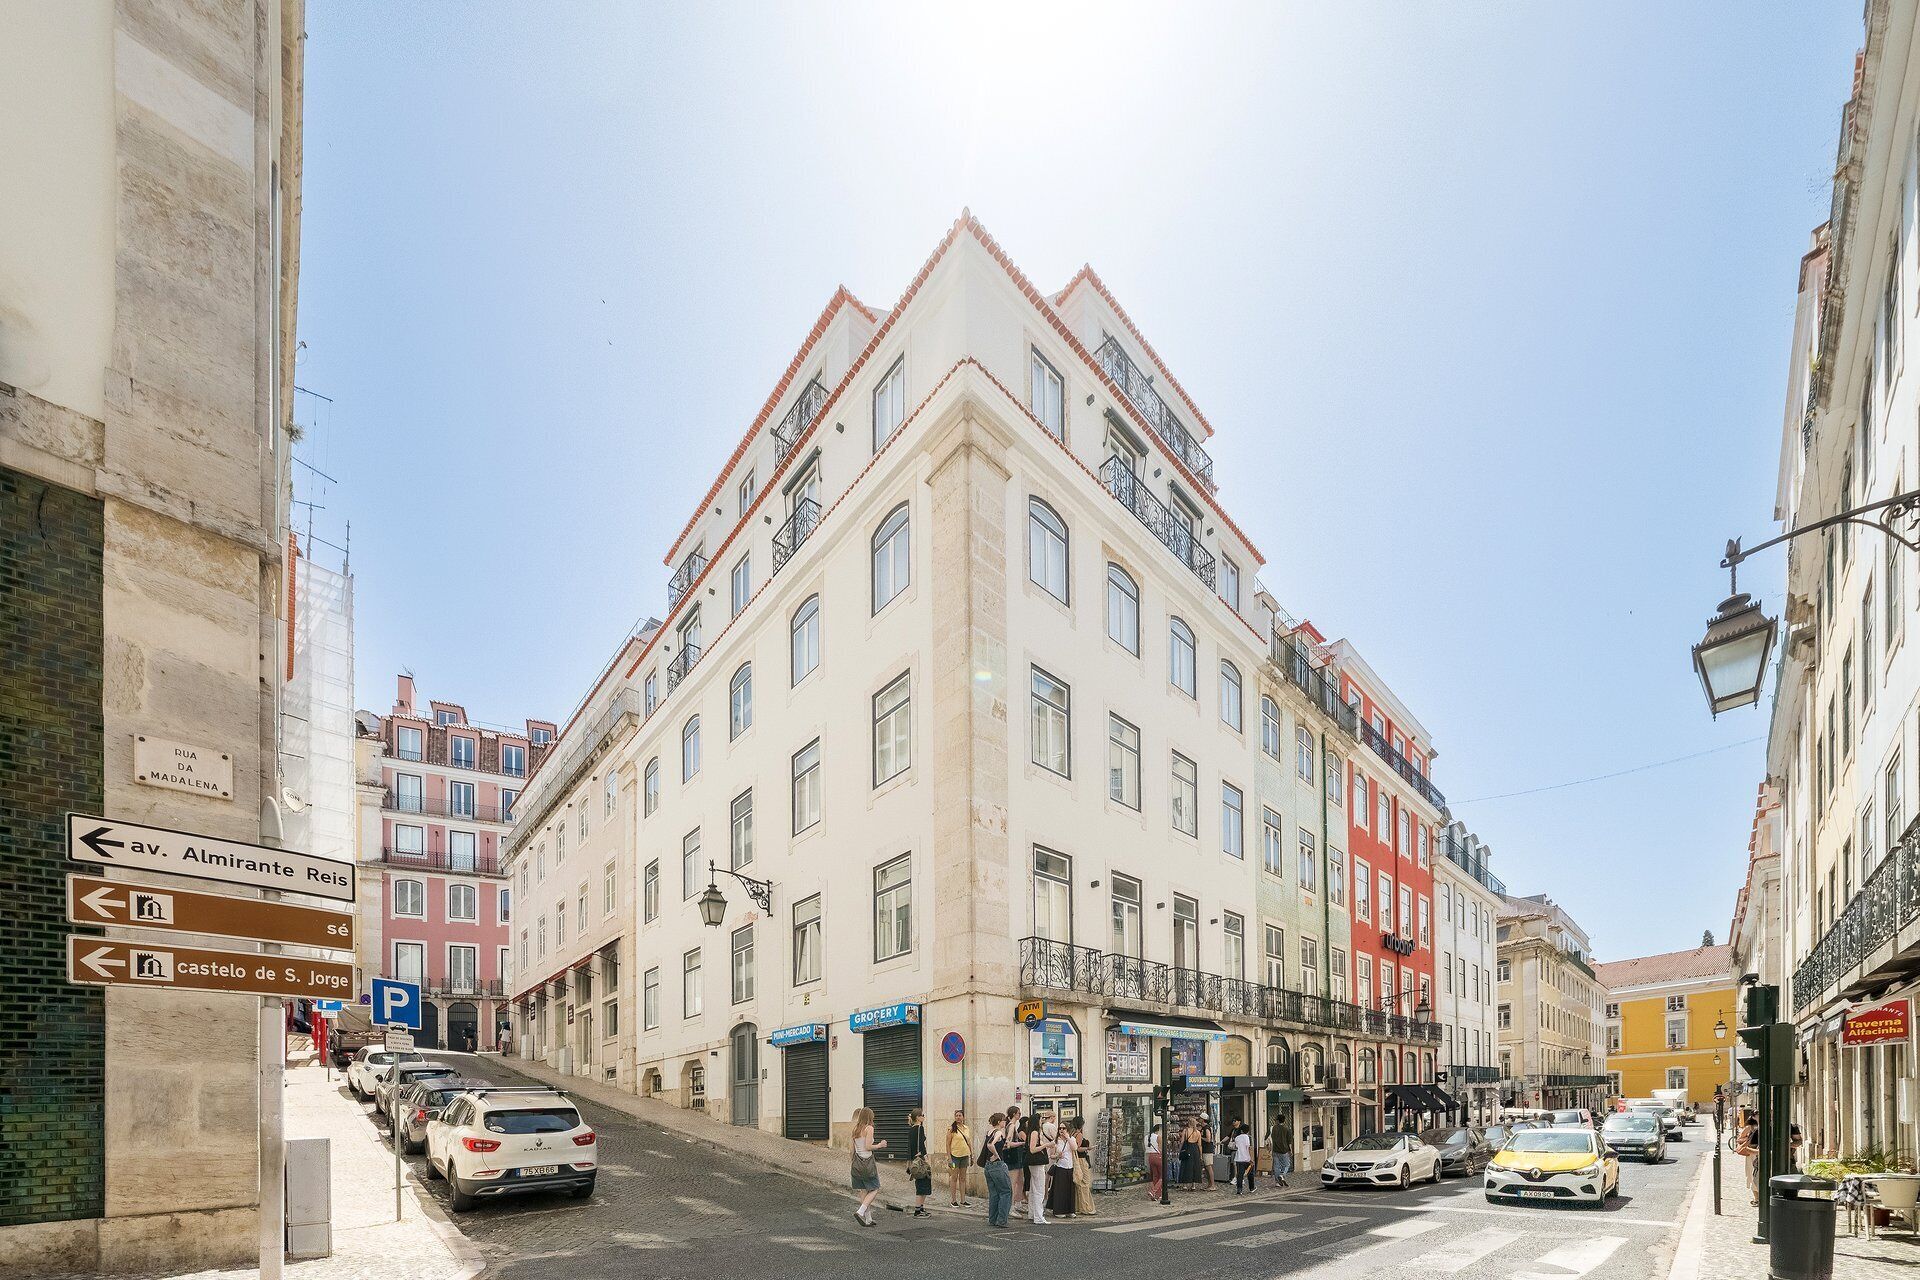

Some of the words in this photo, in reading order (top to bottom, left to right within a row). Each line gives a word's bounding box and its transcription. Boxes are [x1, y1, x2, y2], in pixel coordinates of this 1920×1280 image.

[174, 748, 197, 760] RUA
[177, 762, 193, 773] DA
[150, 770, 219, 792] MADALENA
[130, 840, 168, 857] av.
[182, 846, 295, 878] Almirante
[307, 866, 348, 887] Reis
[326, 922, 349, 937] sé
[176, 961, 246, 979] castelo
[255, 965, 276, 981] de
[284, 968, 301, 983] S.
[307, 970, 349, 989] Jorge
[383, 986, 410, 1020] P
[1022, 1003, 1040, 1012] ATM
[854, 1005, 899, 1023] GROCERY
[1848, 1018, 1902, 1029] Taverna
[773, 1026, 811, 1040] MINI-MERCADO
[1848, 1027, 1904, 1037] Alfacinha
